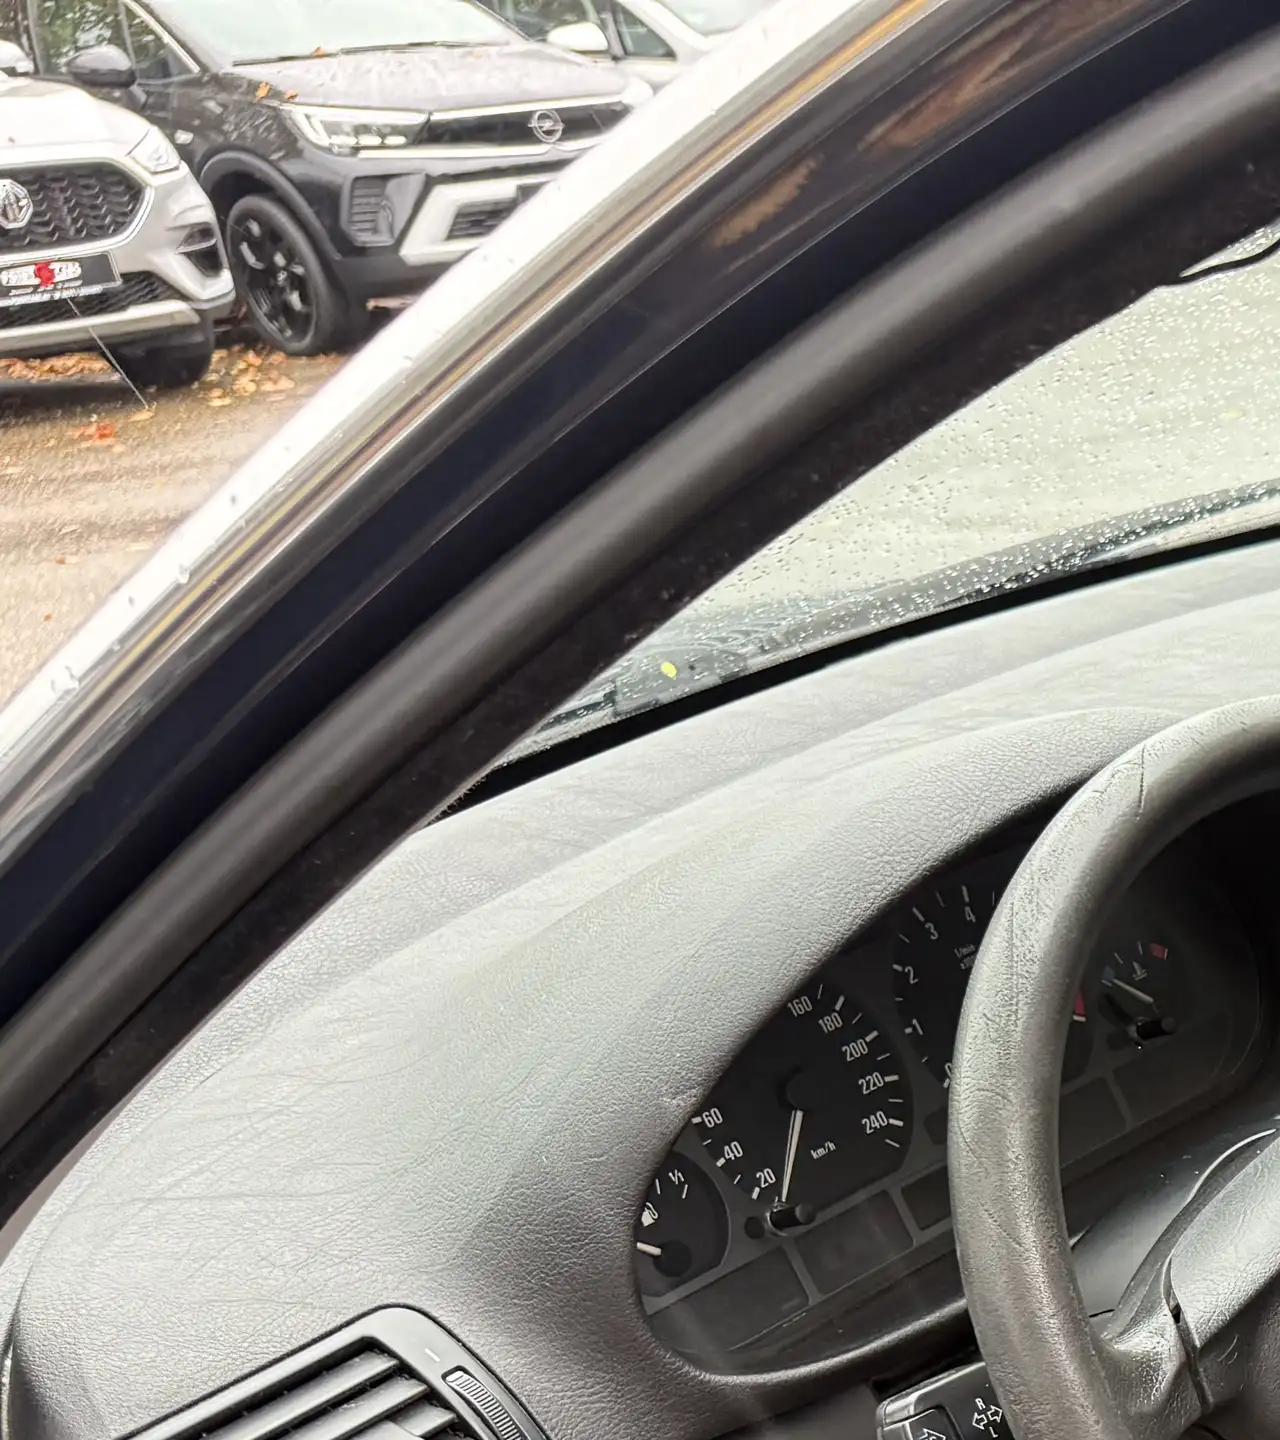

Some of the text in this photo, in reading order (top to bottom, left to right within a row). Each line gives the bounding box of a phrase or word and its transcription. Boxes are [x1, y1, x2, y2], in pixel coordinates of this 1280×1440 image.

[964, 905, 976, 923] 4
[925, 922, 939, 940] 3
[904, 966, 919, 984] 2
[788, 995, 813, 1017] 160
[818, 1012, 843, 1033] 180
[912, 1019, 923, 1036] 1
[842, 1039, 868, 1062] 200
[858, 1072, 884, 1094] 220
[702, 1107, 723, 1128] 60
[862, 1110, 888, 1134] 240
[724, 1141, 743, 1161] 40
[810, 1140, 836, 1160] km/h
[756, 1168, 776, 1189] 20
[975, 1397, 986, 1411] R
[989, 1426, 999, 1439] L
